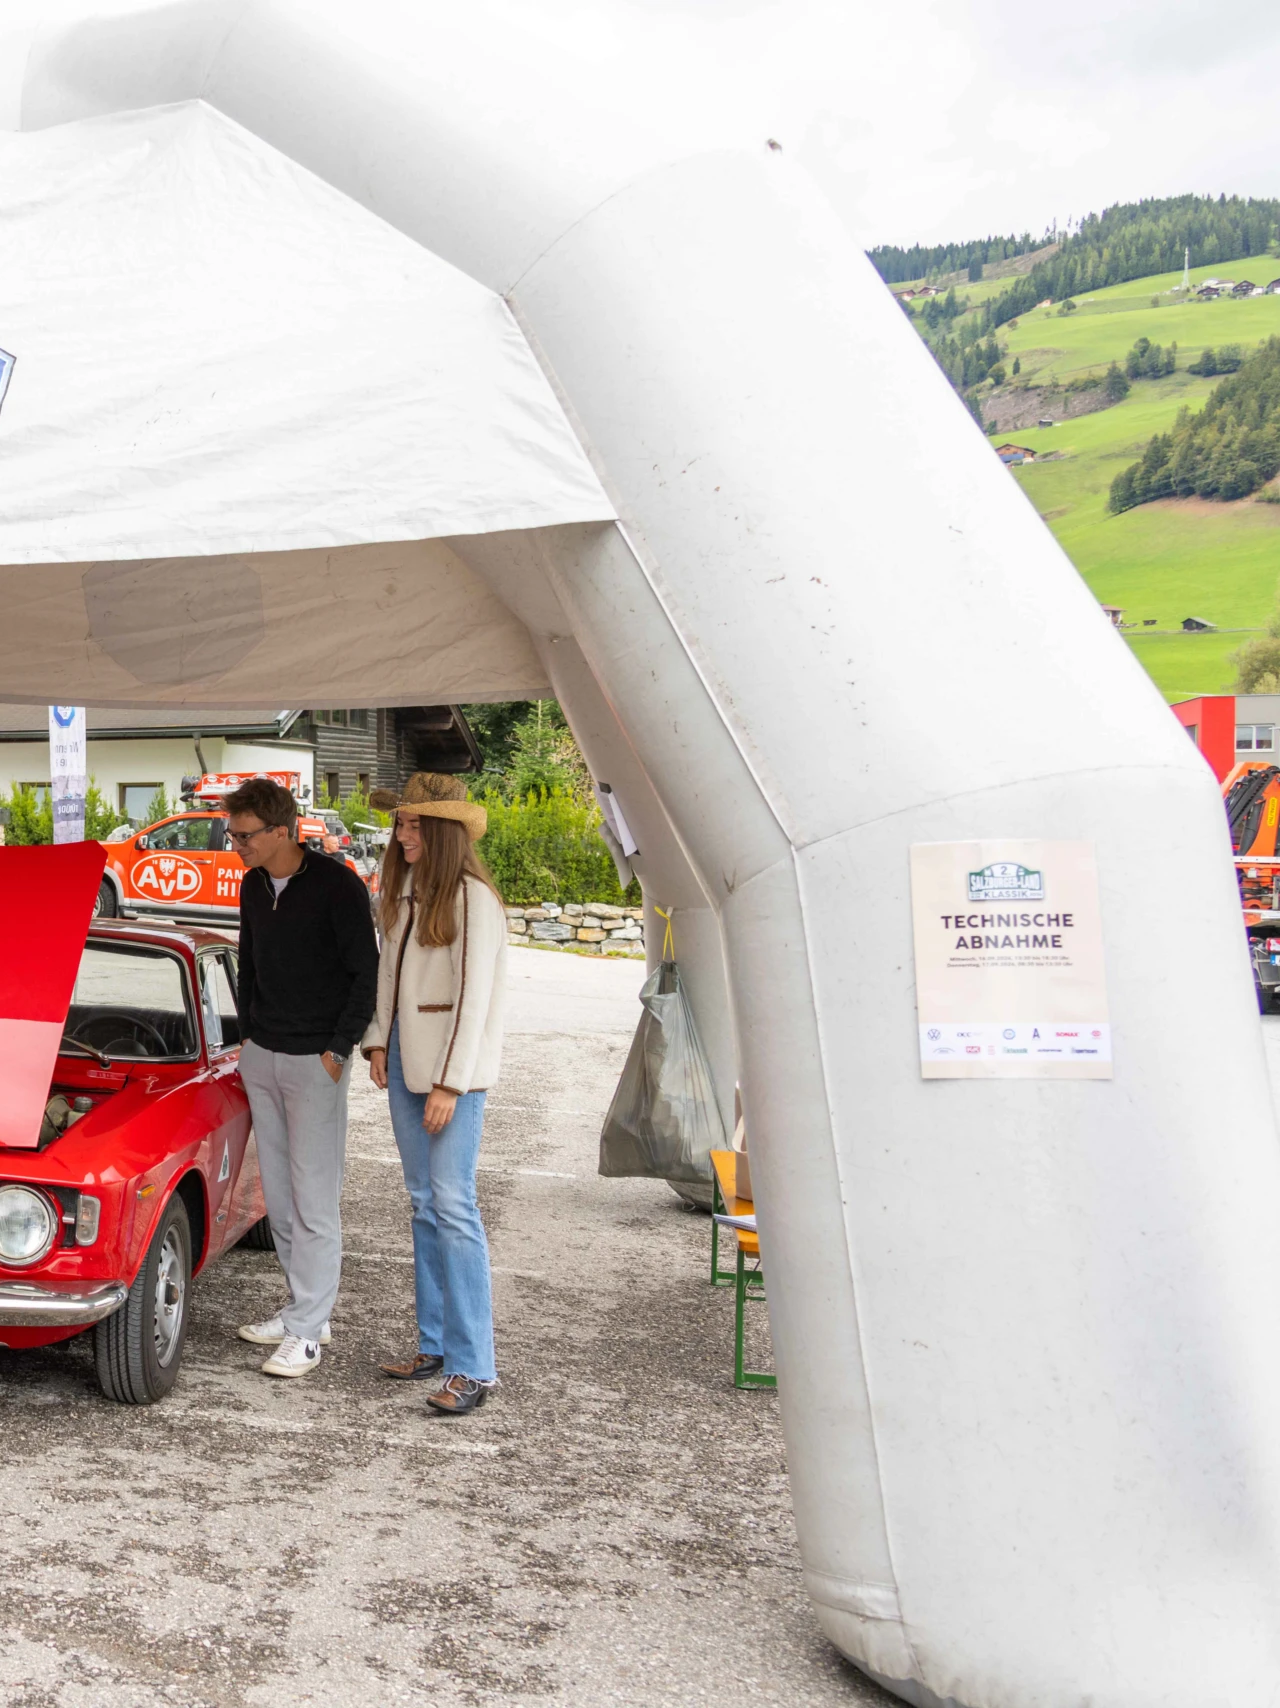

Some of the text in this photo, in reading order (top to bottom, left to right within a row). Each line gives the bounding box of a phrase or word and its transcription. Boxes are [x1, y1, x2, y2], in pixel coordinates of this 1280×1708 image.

[217, 868, 248, 880] PAN
[984, 890, 1028, 898] KLASSIK
[941, 913, 1074, 929] TECHNISCHE
[955, 934, 1063, 950] ABNAHME
